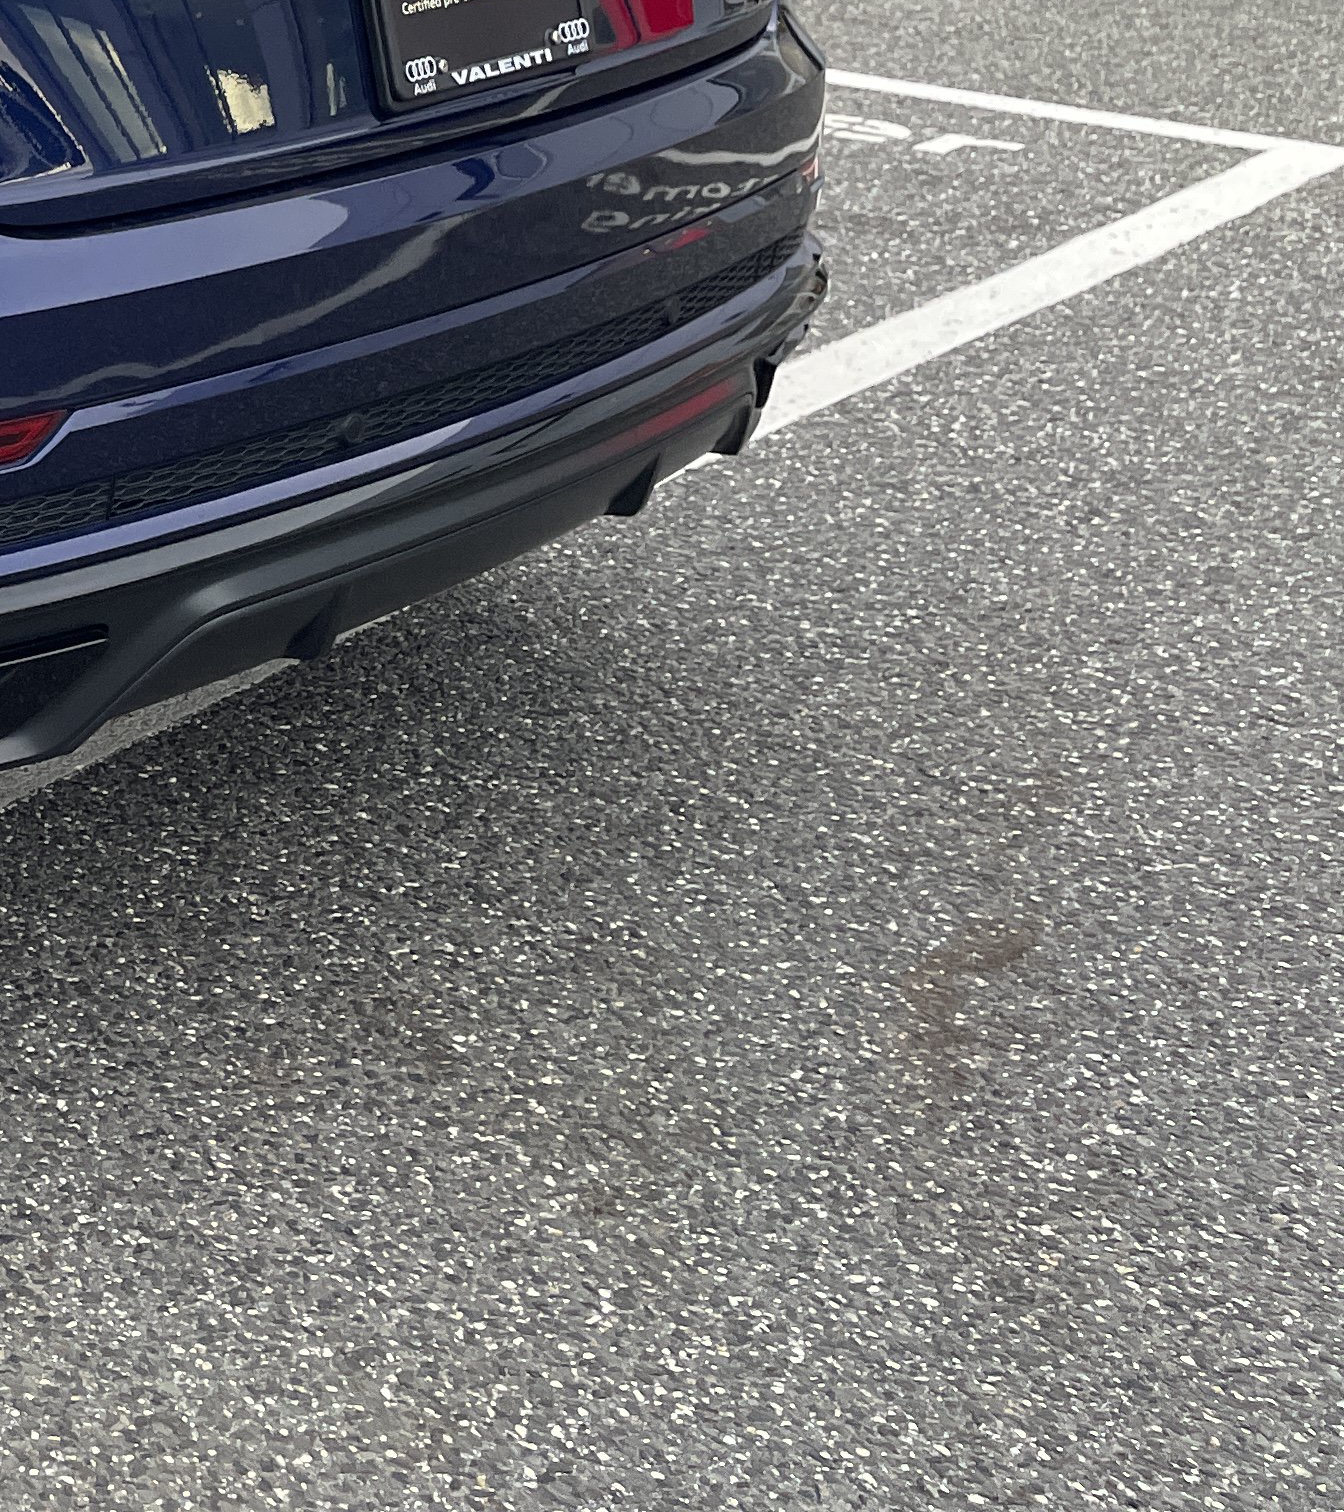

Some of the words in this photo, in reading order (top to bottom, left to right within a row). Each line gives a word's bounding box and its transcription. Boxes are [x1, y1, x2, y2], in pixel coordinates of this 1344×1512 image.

[567, 39, 589, 56] Audi
[451, 47, 553, 86] VALENTI
[414, 78, 437, 97] Audi
